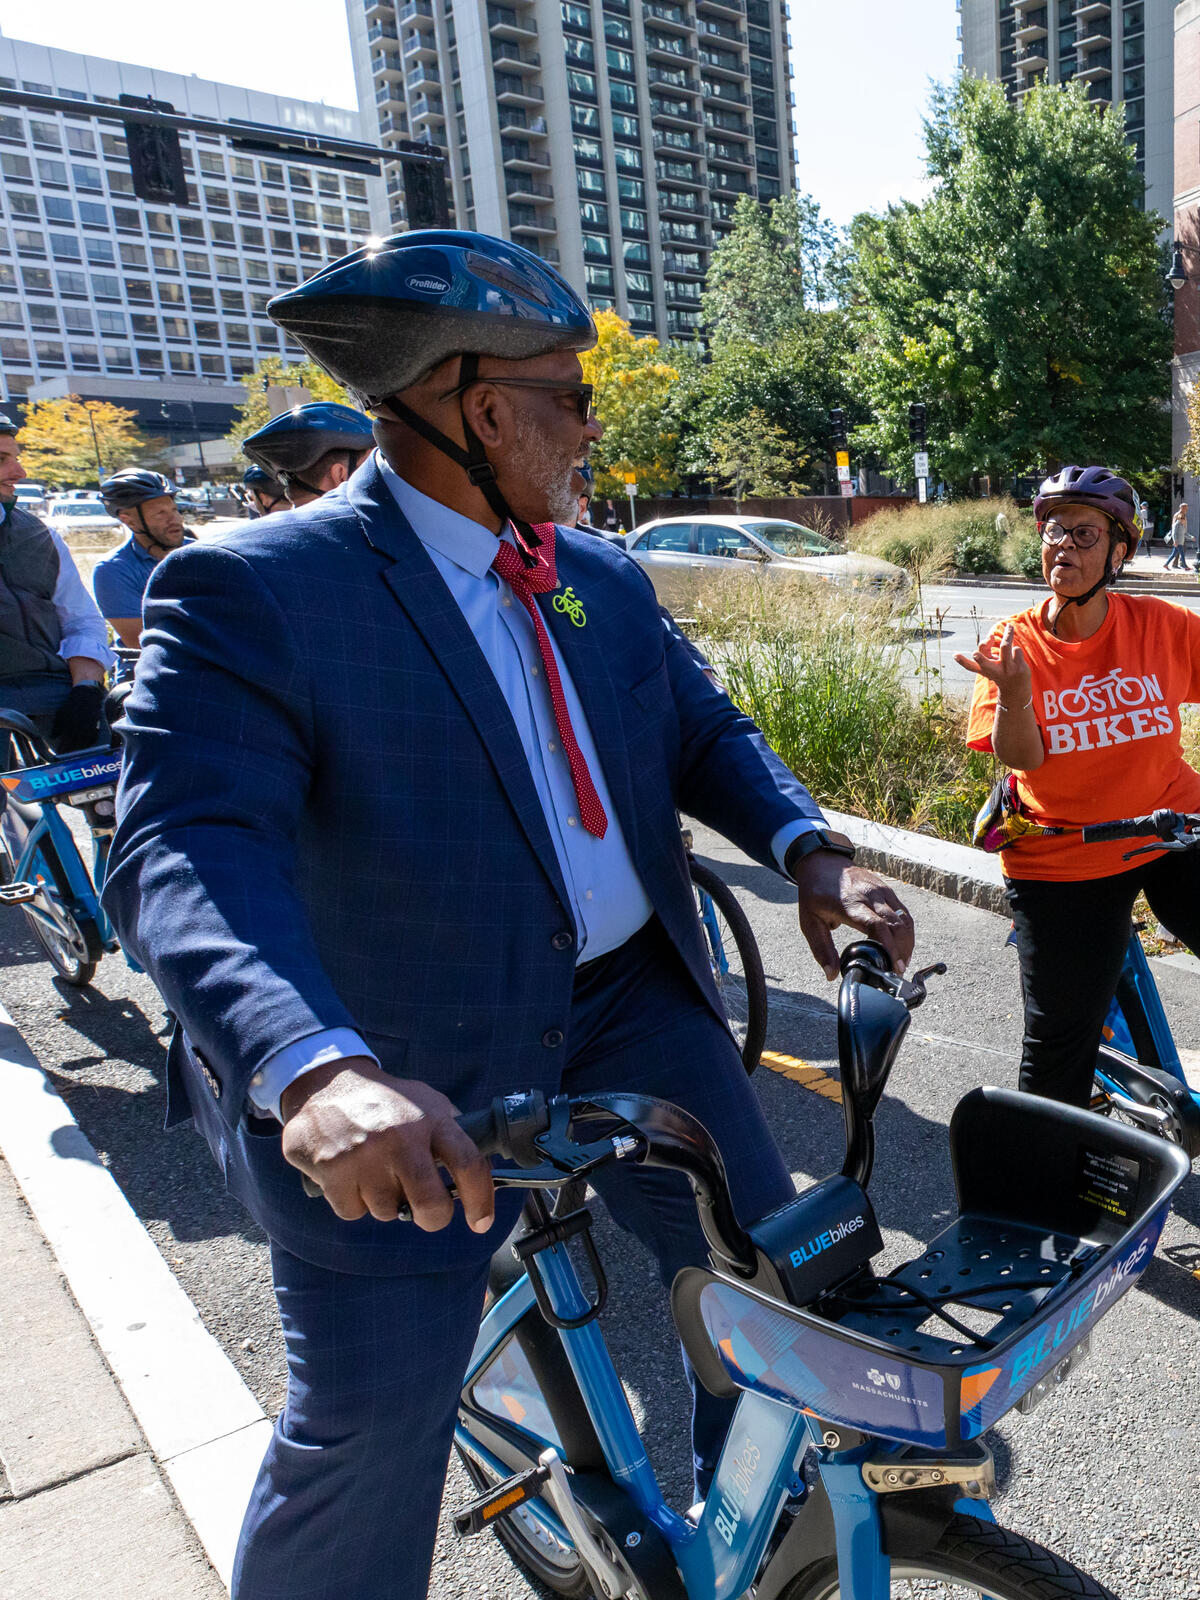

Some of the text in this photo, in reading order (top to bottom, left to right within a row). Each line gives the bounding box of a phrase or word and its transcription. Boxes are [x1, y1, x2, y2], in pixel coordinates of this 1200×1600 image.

[410, 278, 446, 290] ProRider
[1042, 671, 1165, 720] BOSTON
[1046, 705, 1174, 755] BIKES
[789, 1214, 864, 1269] BLUEbikes
[1009, 1237, 1149, 1389] BLUEbikes
[852, 1382, 929, 1408] MASSACHUSETTS
[714, 1438, 761, 1547] BLUEbikes
